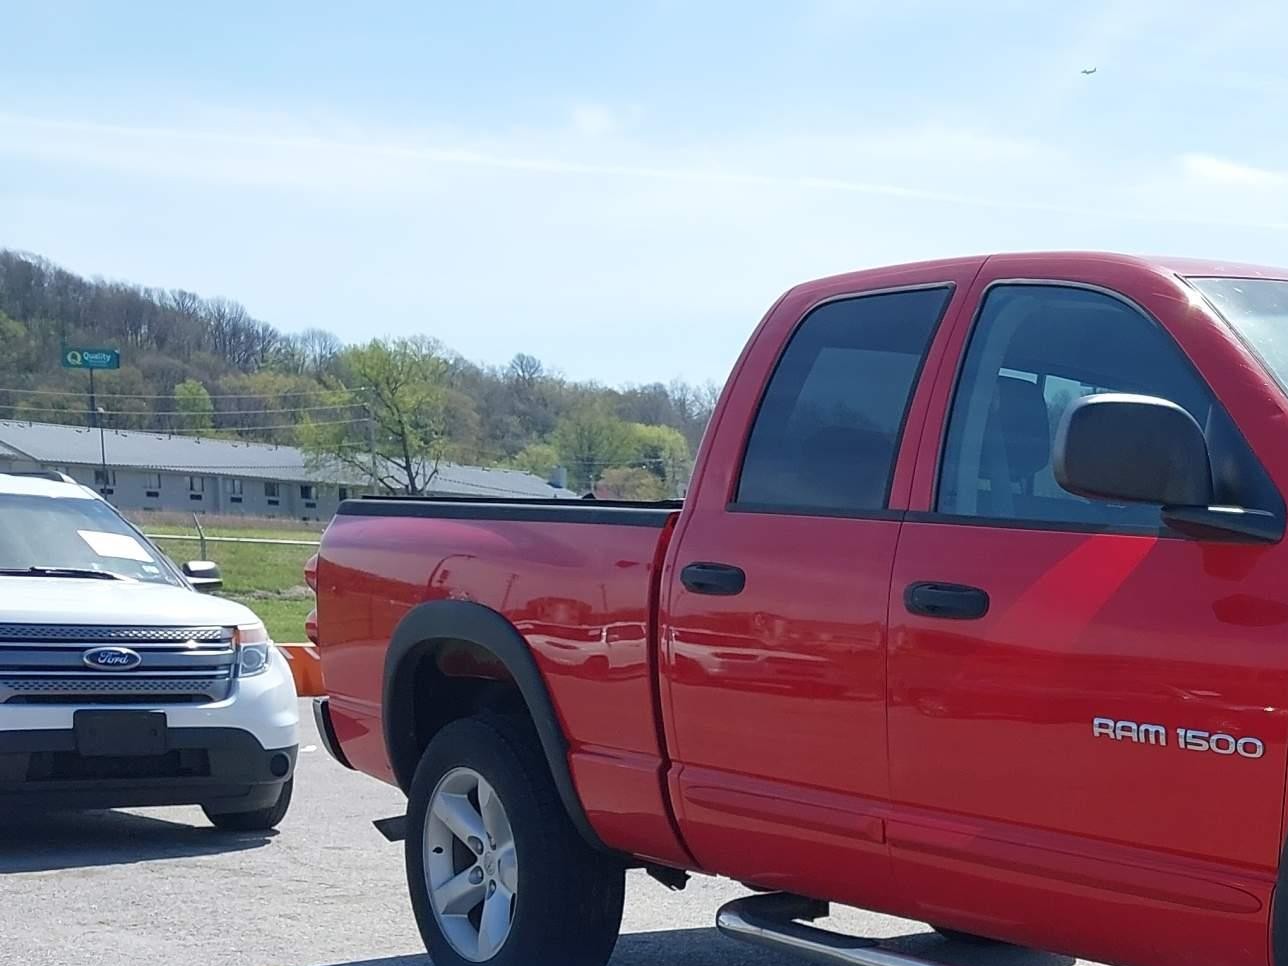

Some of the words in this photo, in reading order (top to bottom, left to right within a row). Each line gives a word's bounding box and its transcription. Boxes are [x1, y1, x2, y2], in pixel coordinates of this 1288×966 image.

[83, 351, 111, 362] Quality
[98, 651, 129, 664] Ford
[1093, 717, 1167, 746] RAM
[1176, 728, 1264, 758] 1500
